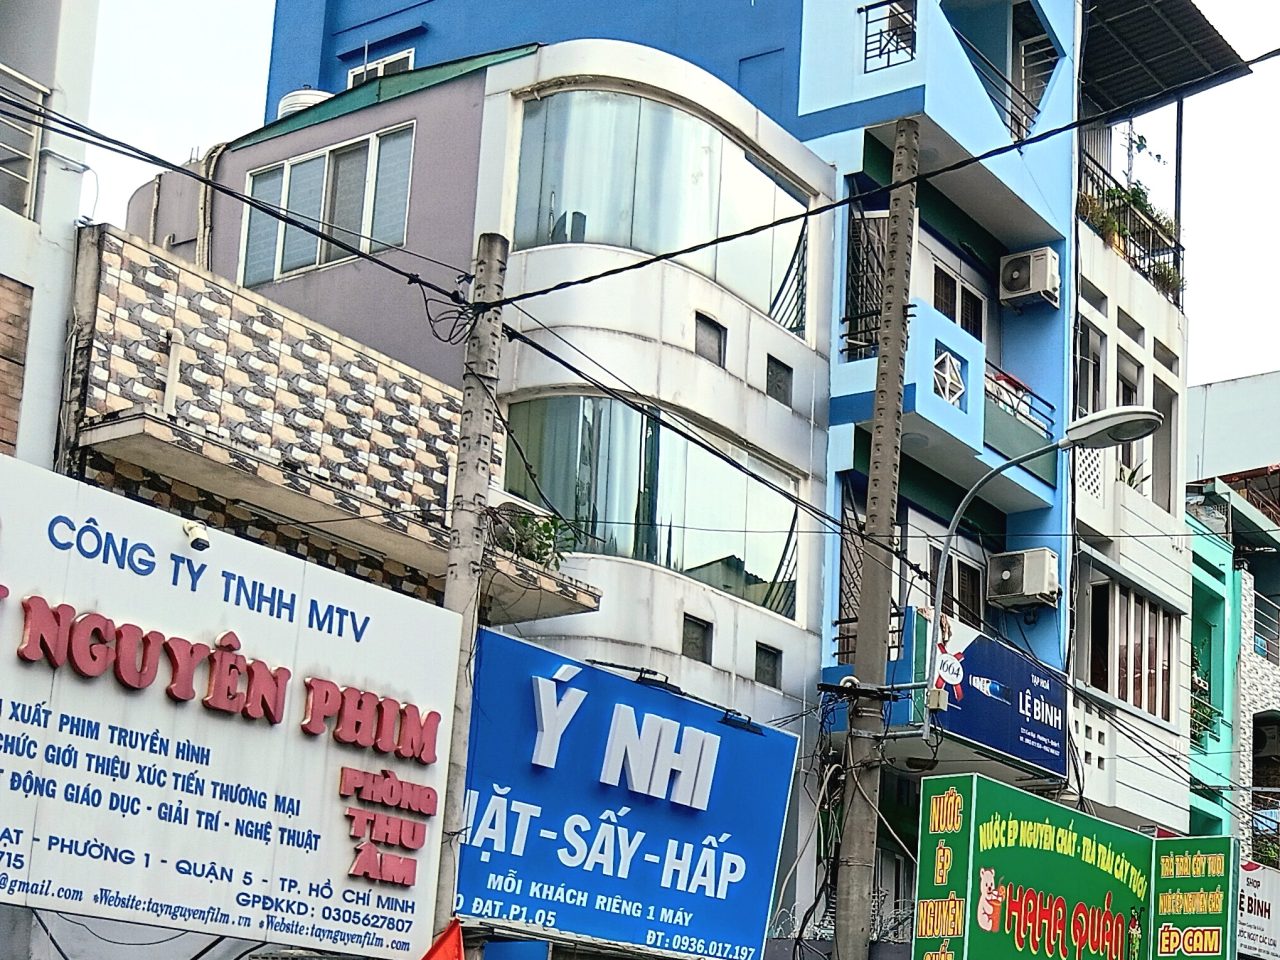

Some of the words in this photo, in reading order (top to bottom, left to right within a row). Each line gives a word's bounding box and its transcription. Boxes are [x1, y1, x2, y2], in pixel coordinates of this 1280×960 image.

[48, 516, 156, 576] CÔNG
[170, 553, 207, 592] TY
[222, 570, 296, 623] TNHH
[308, 599, 371, 643] MTV
[17, 594, 292, 725] NGUYÊN
[301, 677, 443, 766] PHIM
[940, 659, 961, 678] 1664
[1019, 689, 1031, 722] LỆ
[1033, 696, 1062, 730] BÌNH
[9, 701, 52, 729] XUẤT
[58, 713, 100, 741] PHIM
[108, 725, 170, 757] TRUYỀN
[175, 739, 211, 766] HÌNH
[531, 664, 588, 769] Ý
[599, 703, 721, 811] NHI
[44, 743, 78, 769] GIỚI
[85, 753, 130, 781] THIỆU
[136, 760, 167, 787] XÚC
[172, 770, 205, 796] TIẾN
[211, 780, 267, 810] THƯƠNG
[274, 794, 301, 818] MẠI
[339, 767, 437, 816] PHÒNG
[10, 770, 57, 798] ĐỘNG
[64, 783, 102, 807] GIÁO
[109, 792, 141, 817] DỤC
[158, 800, 188, 825] GIẢI
[196, 810, 221, 832] TRÍ
[235, 818, 272, 845] NGHỆ
[278, 827, 321, 853] THUẬT
[344, 807, 426, 850] THU
[929, 787, 963, 834] NƯỚC
[348, 841, 417, 886] ÂM
[461, 783, 747, 900] IẶT-SẤY-HẤP
[934, 839, 952, 886] ÉP
[979, 812, 1006, 852] NƯỚC
[1007, 812, 1019, 848] ÉP
[1020, 817, 1055, 852] NGUYÊN
[1056, 819, 1078, 858] CHẤT
[1081, 833, 1096, 866] TRÀ
[1097, 841, 1115, 875] TRÁI
[1114, 852, 1130, 885] CÂY
[48, 835, 135, 865] PHƯỜNG
[144, 853, 151, 868] 1
[175, 859, 233, 883] QUẬN
[243, 872, 253, 886] 5
[279, 878, 301, 894] TP.
[308, 879, 333, 899] HỒ
[342, 889, 372, 907] CHÍ
[377, 895, 415, 914] MINH
[487, 869, 522, 895] MỖI
[529, 881, 589, 907] KHÁCH
[595, 894, 642, 918] RIÊNG
[647, 905, 656, 921] 1
[659, 904, 693, 927] MÁY
[1246, 877, 1260, 889] SHOP
[236, 892, 315, 918] GPĐKKD:
[322, 906, 413, 934] 0305627807
[917, 891, 965, 938] NGUYÊN
[1239, 889, 1245, 917] Ệ
[1247, 893, 1271, 920] BÌNH
[672, 934, 756, 960] 0936.017.197
[1159, 923, 1181, 956] ÉP
[1182, 927, 1222, 956] CAM
